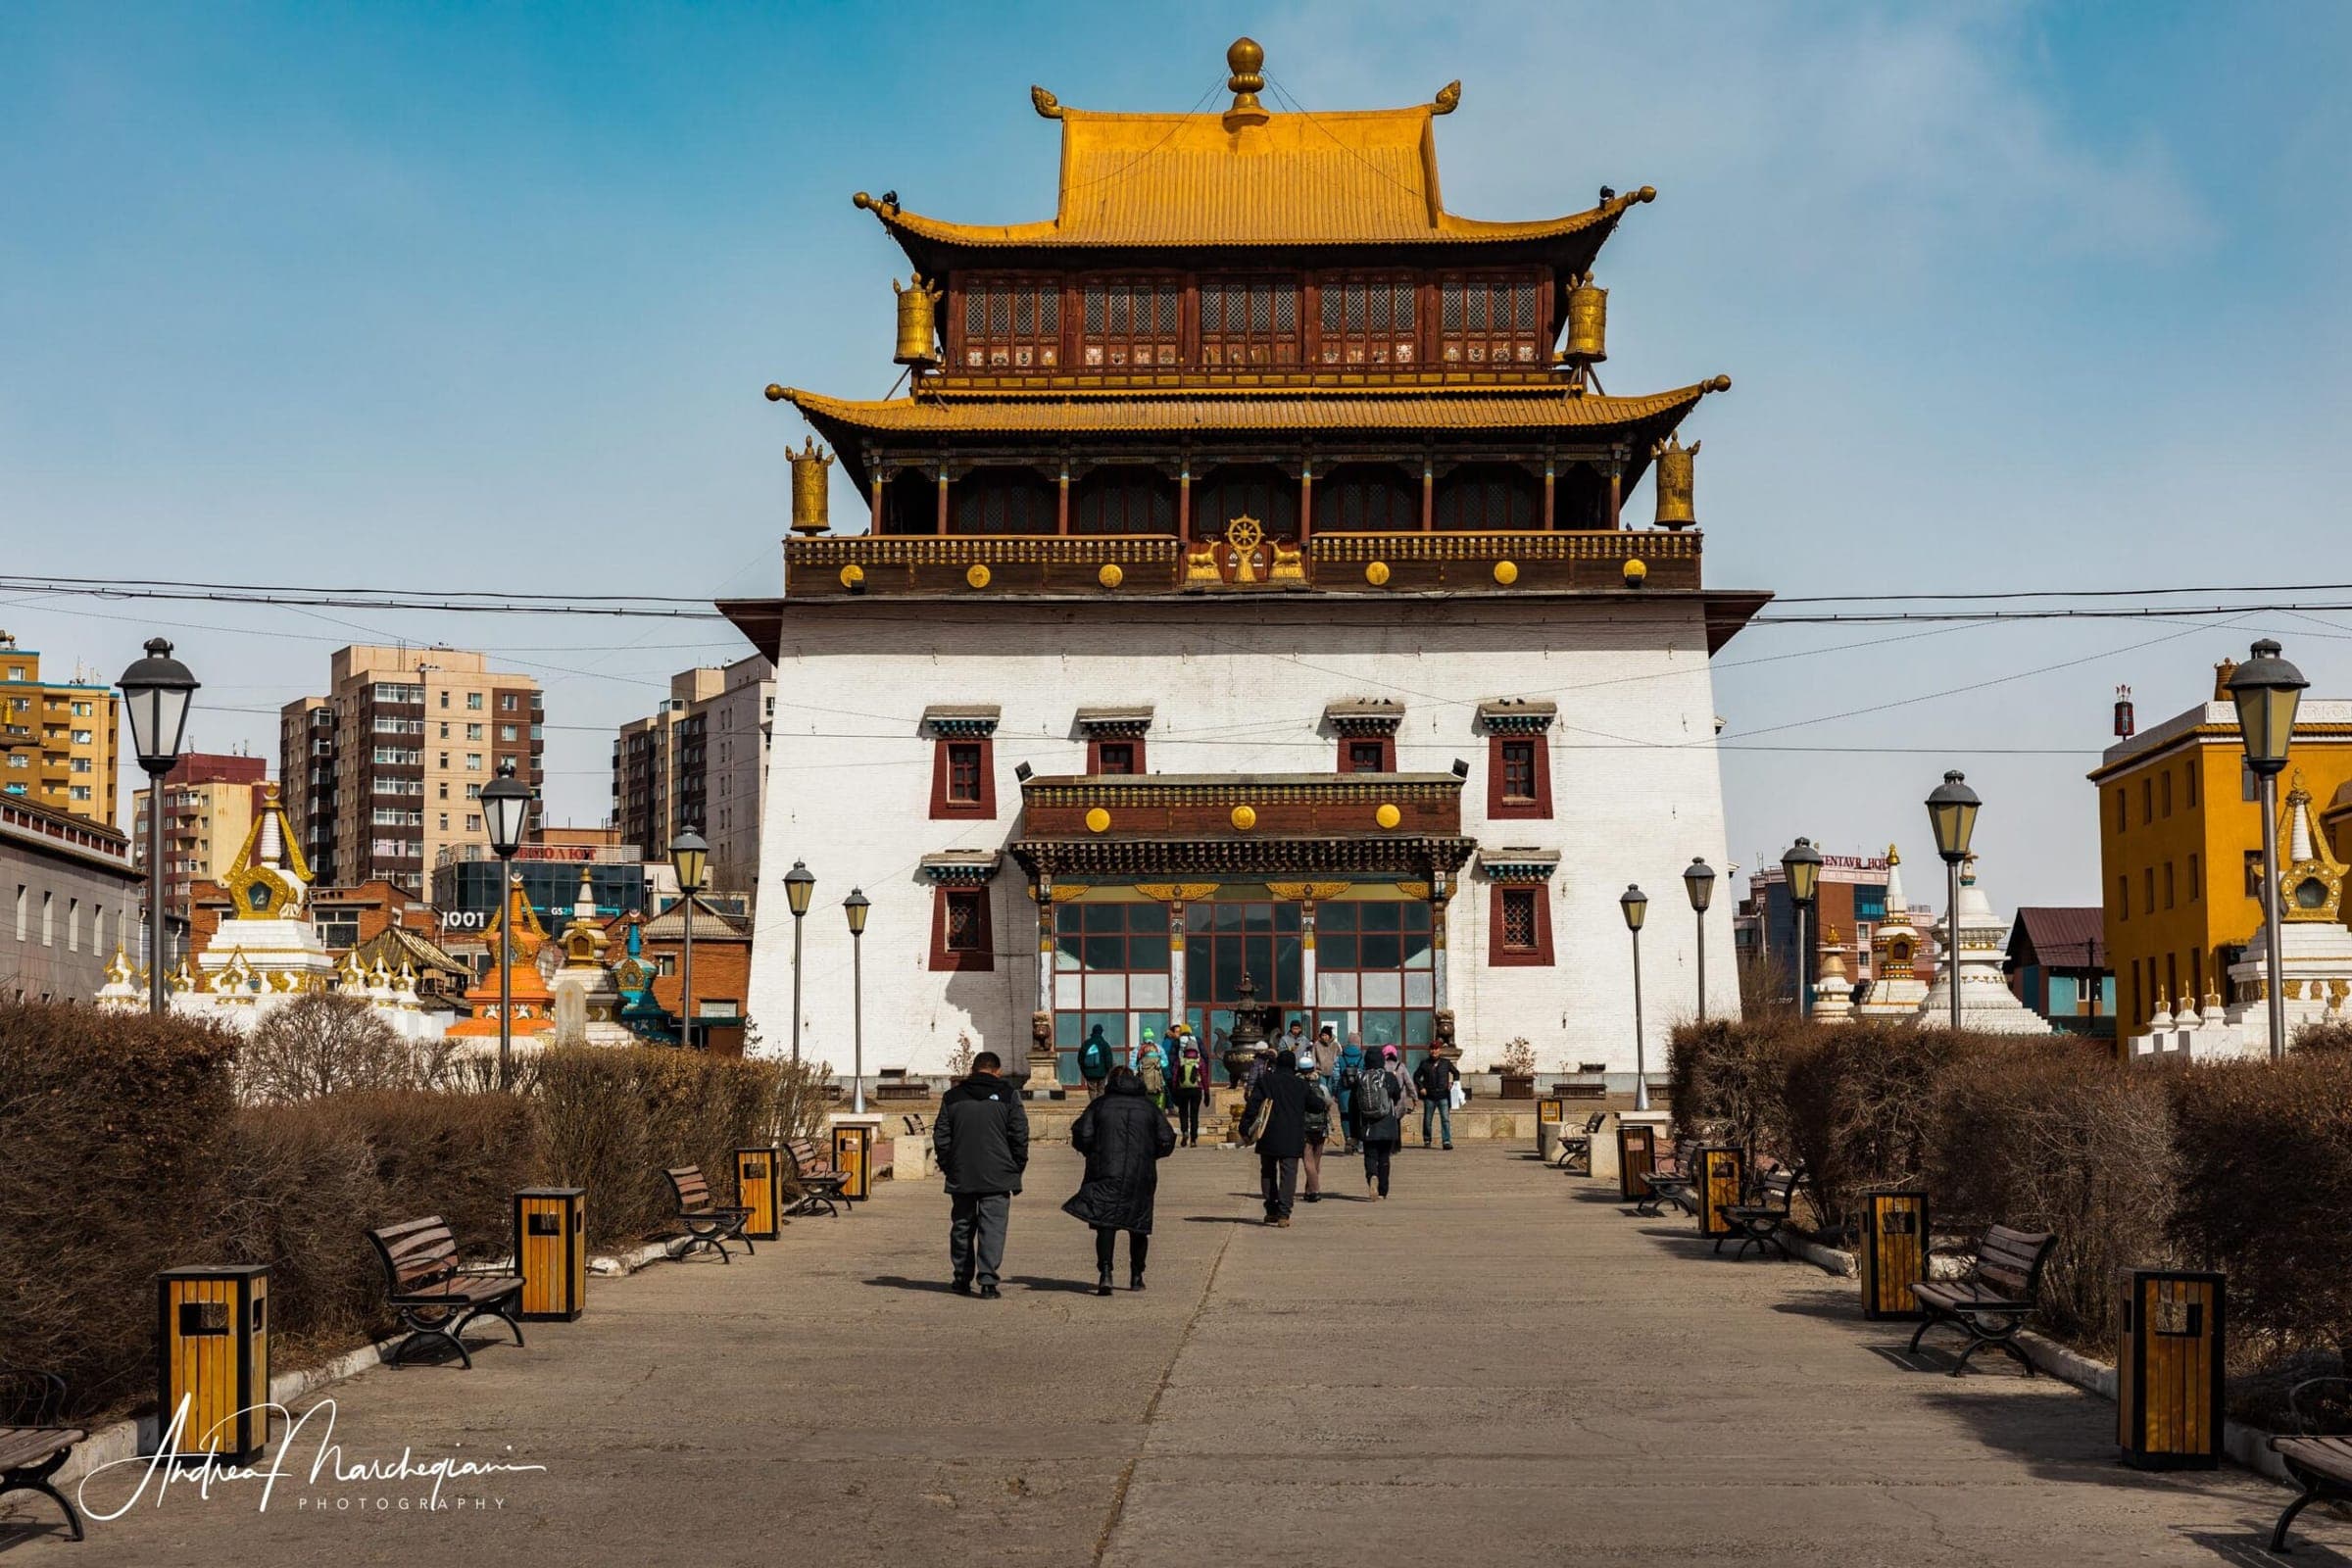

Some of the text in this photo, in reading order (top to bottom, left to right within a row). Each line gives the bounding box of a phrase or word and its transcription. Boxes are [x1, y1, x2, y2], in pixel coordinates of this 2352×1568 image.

[512, 847, 597, 861] БСОЛЮТ
[1820, 855, 1862, 868] ENTAVR
[442, 911, 485, 927] 1001
